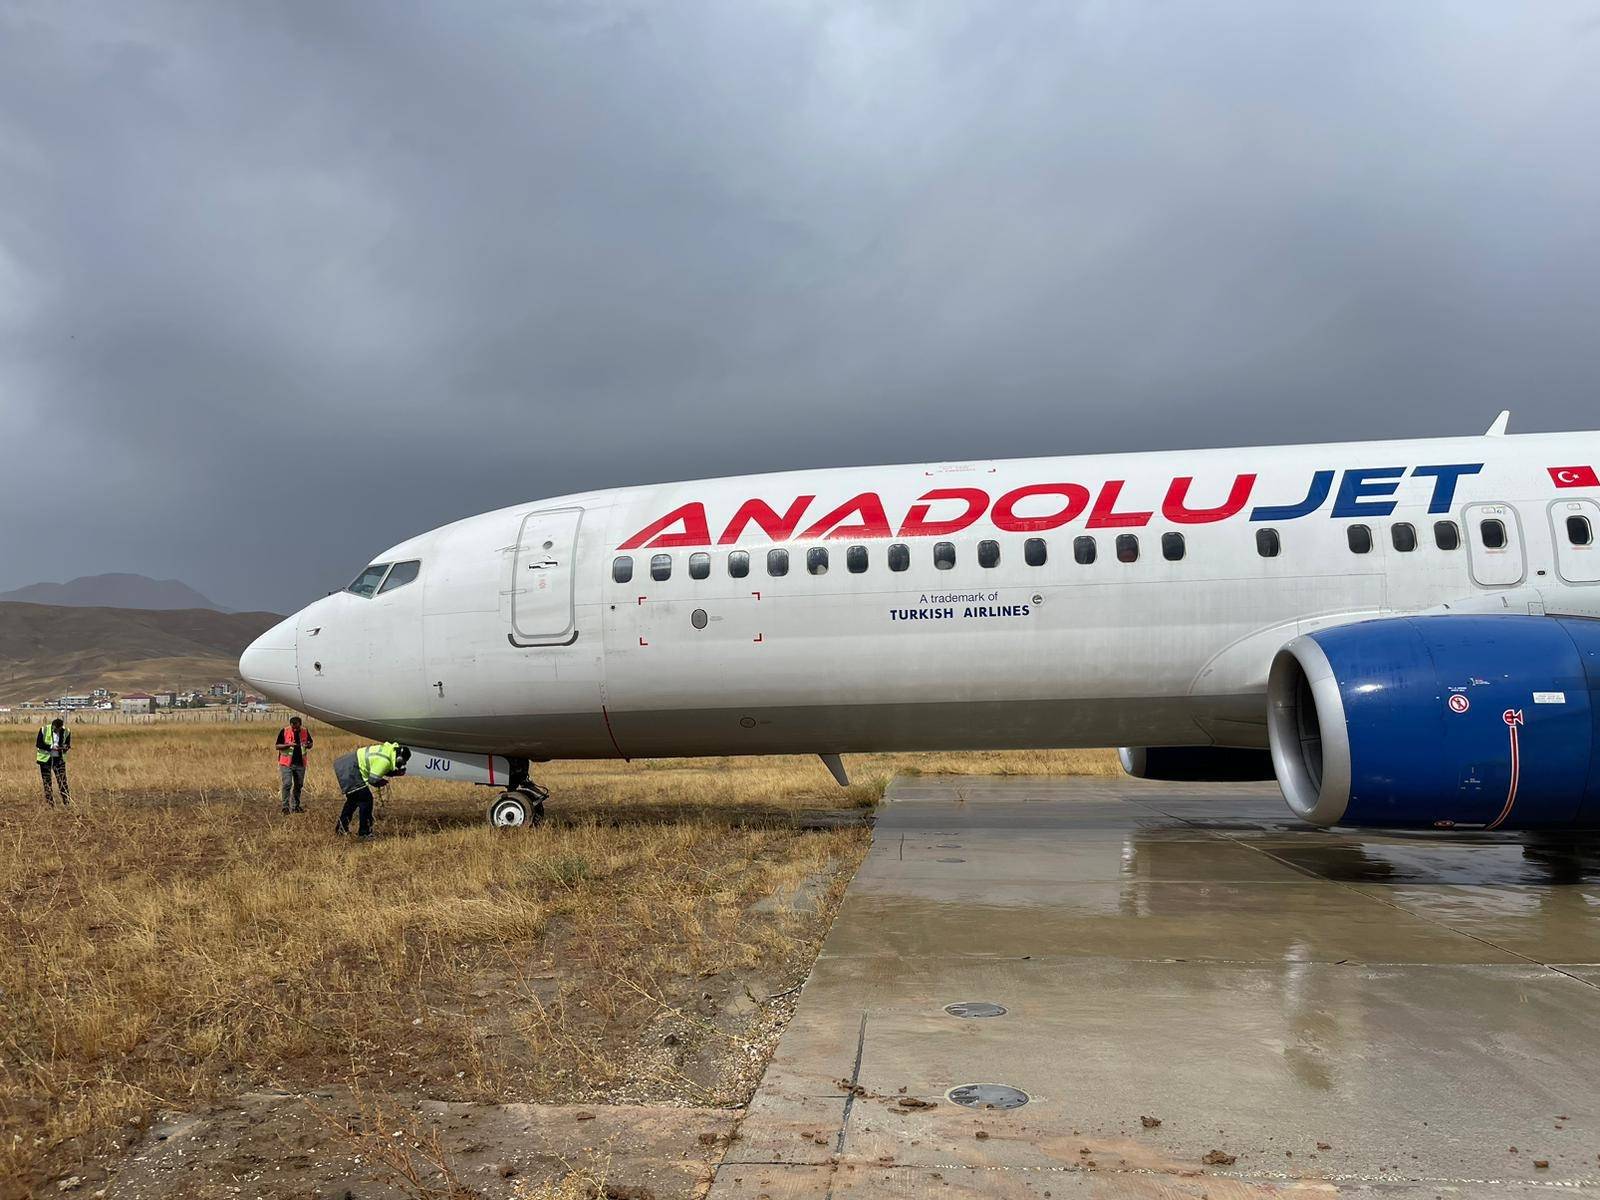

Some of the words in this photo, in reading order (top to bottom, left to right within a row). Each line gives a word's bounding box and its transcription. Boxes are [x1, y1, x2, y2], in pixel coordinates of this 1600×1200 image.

[615, 463, 1484, 551] ANADOLUJET
[919, 594, 928, 604] A
[930, 592, 985, 604] trademark
[987, 591, 998, 601] of
[890, 608, 954, 621] TURKISH
[963, 605, 1030, 618] AIRLINES
[425, 758, 451, 771] JKU
